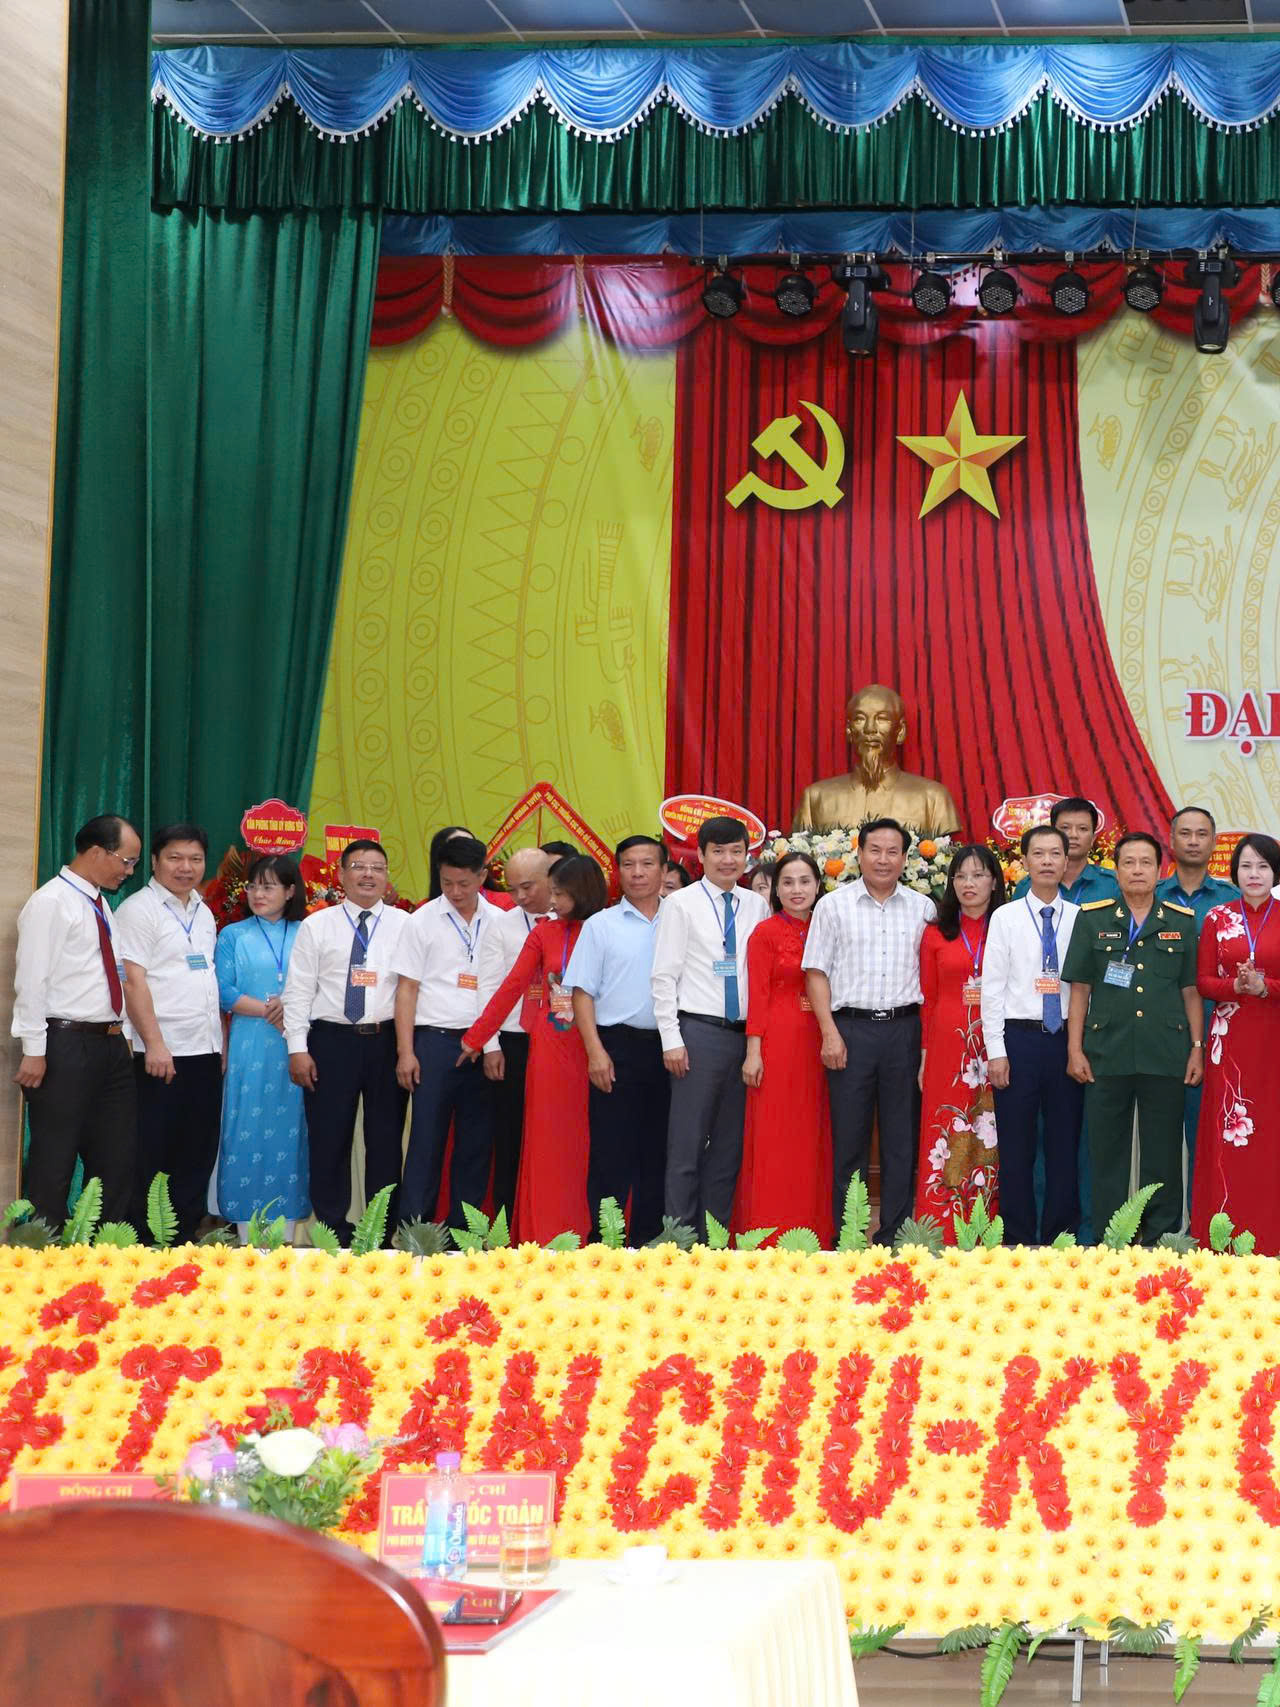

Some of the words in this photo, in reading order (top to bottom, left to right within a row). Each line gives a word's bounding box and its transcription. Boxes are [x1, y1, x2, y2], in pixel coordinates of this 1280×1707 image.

[0, 1263, 224, 1488] ẾT
[606, 1261, 928, 1533] CHỦ
[977, 1265, 1219, 1533] KỶ
